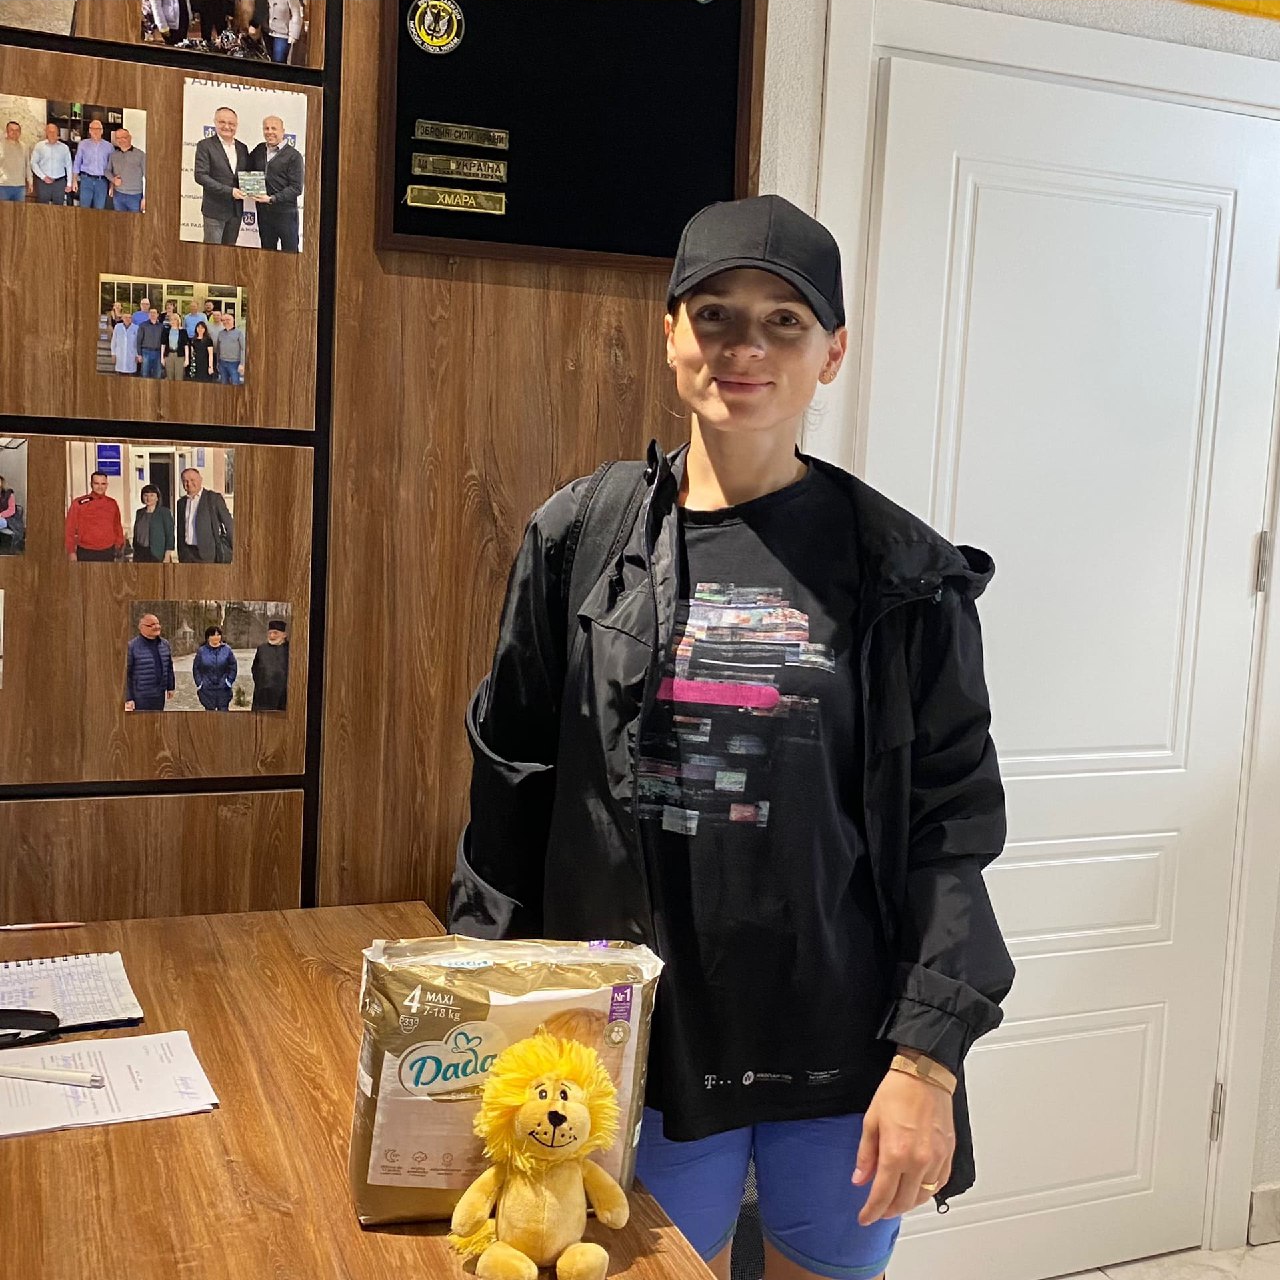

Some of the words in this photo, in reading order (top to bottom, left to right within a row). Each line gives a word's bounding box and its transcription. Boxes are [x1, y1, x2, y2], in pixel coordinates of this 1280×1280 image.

[420, 125, 452, 138] ЗБРОЙНІ
[453, 130, 474, 140] СИЛИ
[456, 160, 501, 174] УКРАЇНА
[436, 192, 476, 207] ХМАРА
[403, 984, 422, 1013] 4
[426, 991, 454, 1005] MAXI
[448, 1009, 461, 1022] kg
[409, 1048, 498, 1087] Dada
